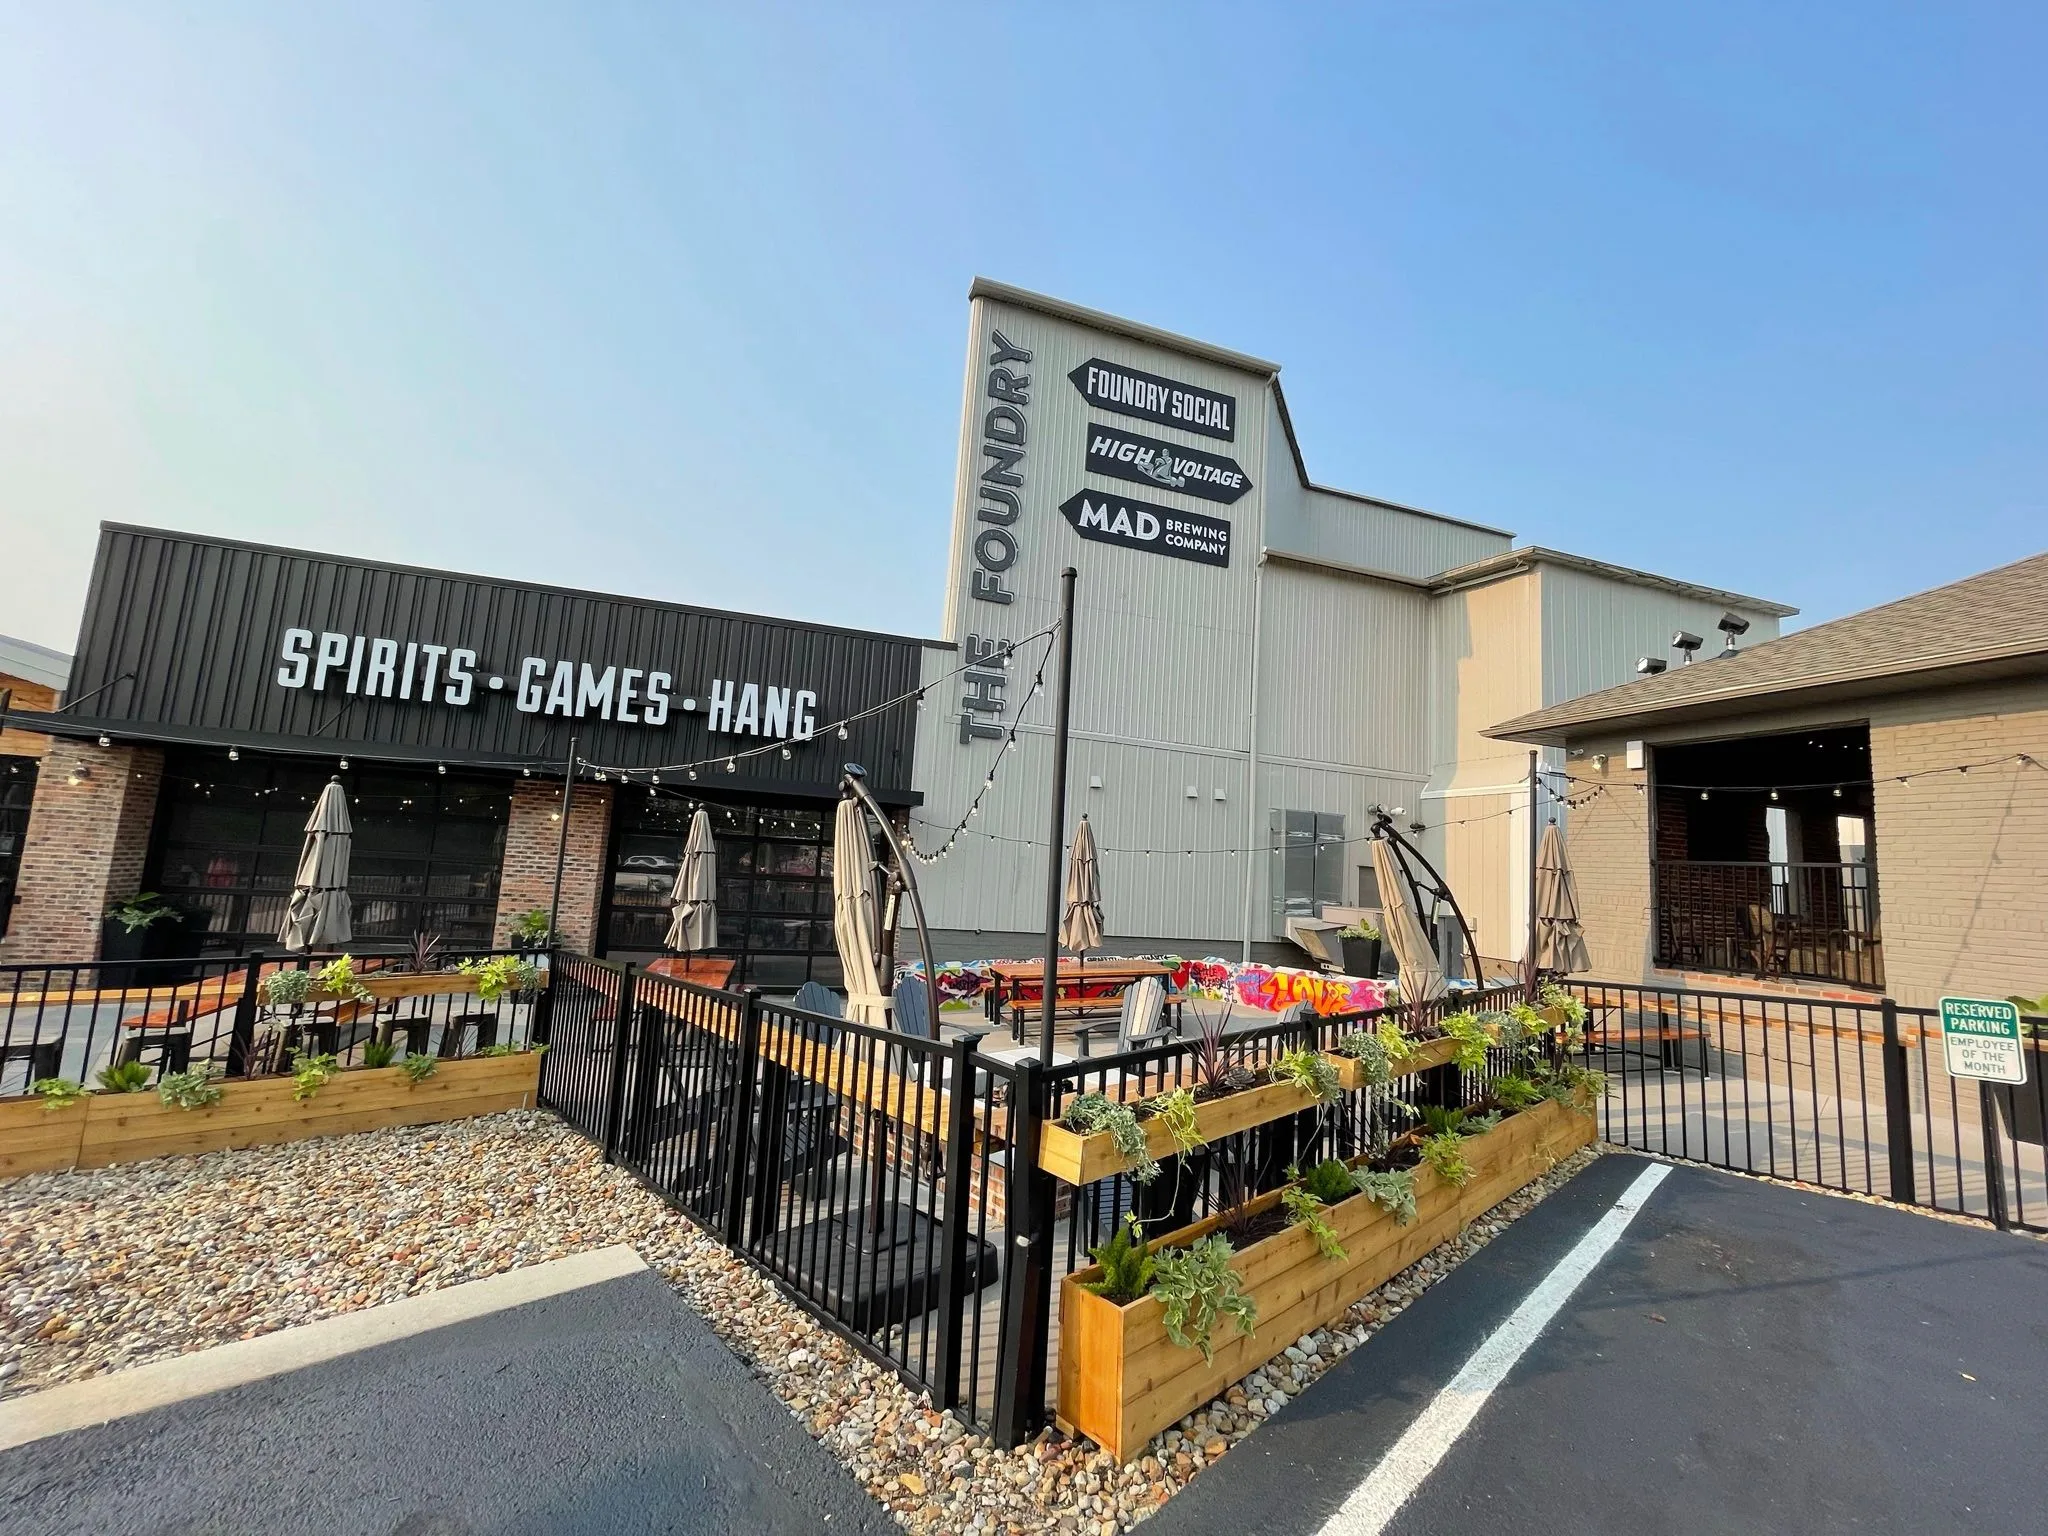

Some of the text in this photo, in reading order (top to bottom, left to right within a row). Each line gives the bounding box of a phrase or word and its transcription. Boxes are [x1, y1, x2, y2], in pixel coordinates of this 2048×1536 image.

[1087, 366, 1230, 431] FOUNDRY SOCIAL
[1090, 435, 1243, 489] HIGH VOLTAGE
[1077, 498, 1161, 541] MAD
[1165, 518, 1227, 542] BREWING
[960, 328, 1033, 745] THE FOUNDRY
[1165, 534, 1226, 556] COMPANY
[277, 628, 817, 742] SPIRITS GAMES HANG
[1945, 1002, 2012, 1020] RESERVED
[1950, 1017, 2010, 1035] PARKING
[1950, 1037, 2015, 1051] EMPLOYEE
[1962, 1049, 2005, 1063] OF THE
[1963, 1060, 2006, 1074] MONTH
